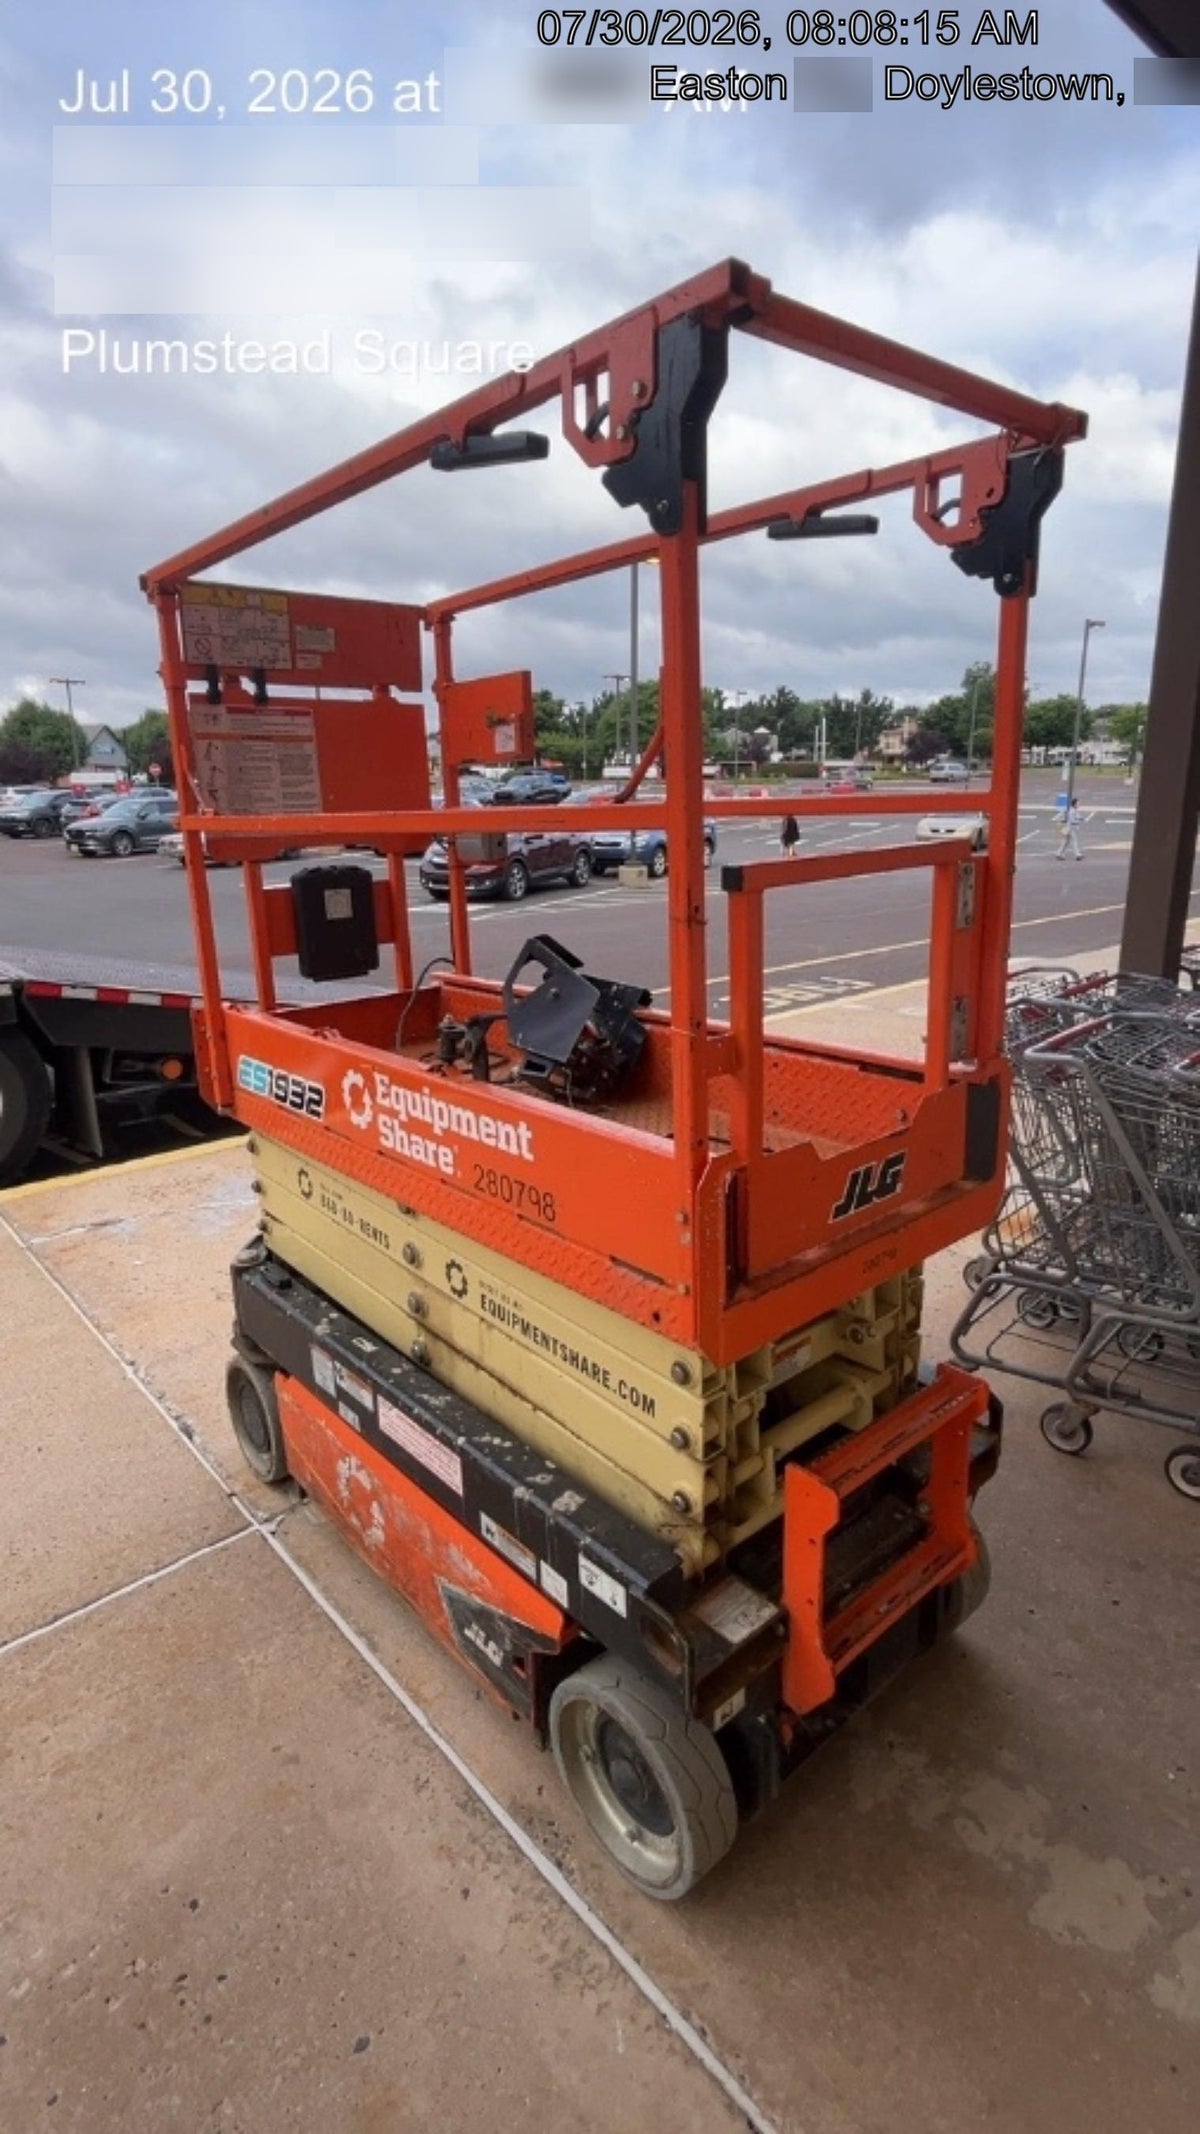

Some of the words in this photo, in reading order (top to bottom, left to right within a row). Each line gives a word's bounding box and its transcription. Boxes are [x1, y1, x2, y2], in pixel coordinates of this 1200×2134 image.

[238, 1054, 325, 1121] ES1932
[373, 1071, 534, 1161] Equipment
[473, 1163, 557, 1222] 280798
[829, 1150, 907, 1222] JLG
[480, 1293, 657, 1419] EQUIPMENTSHARE.COM
